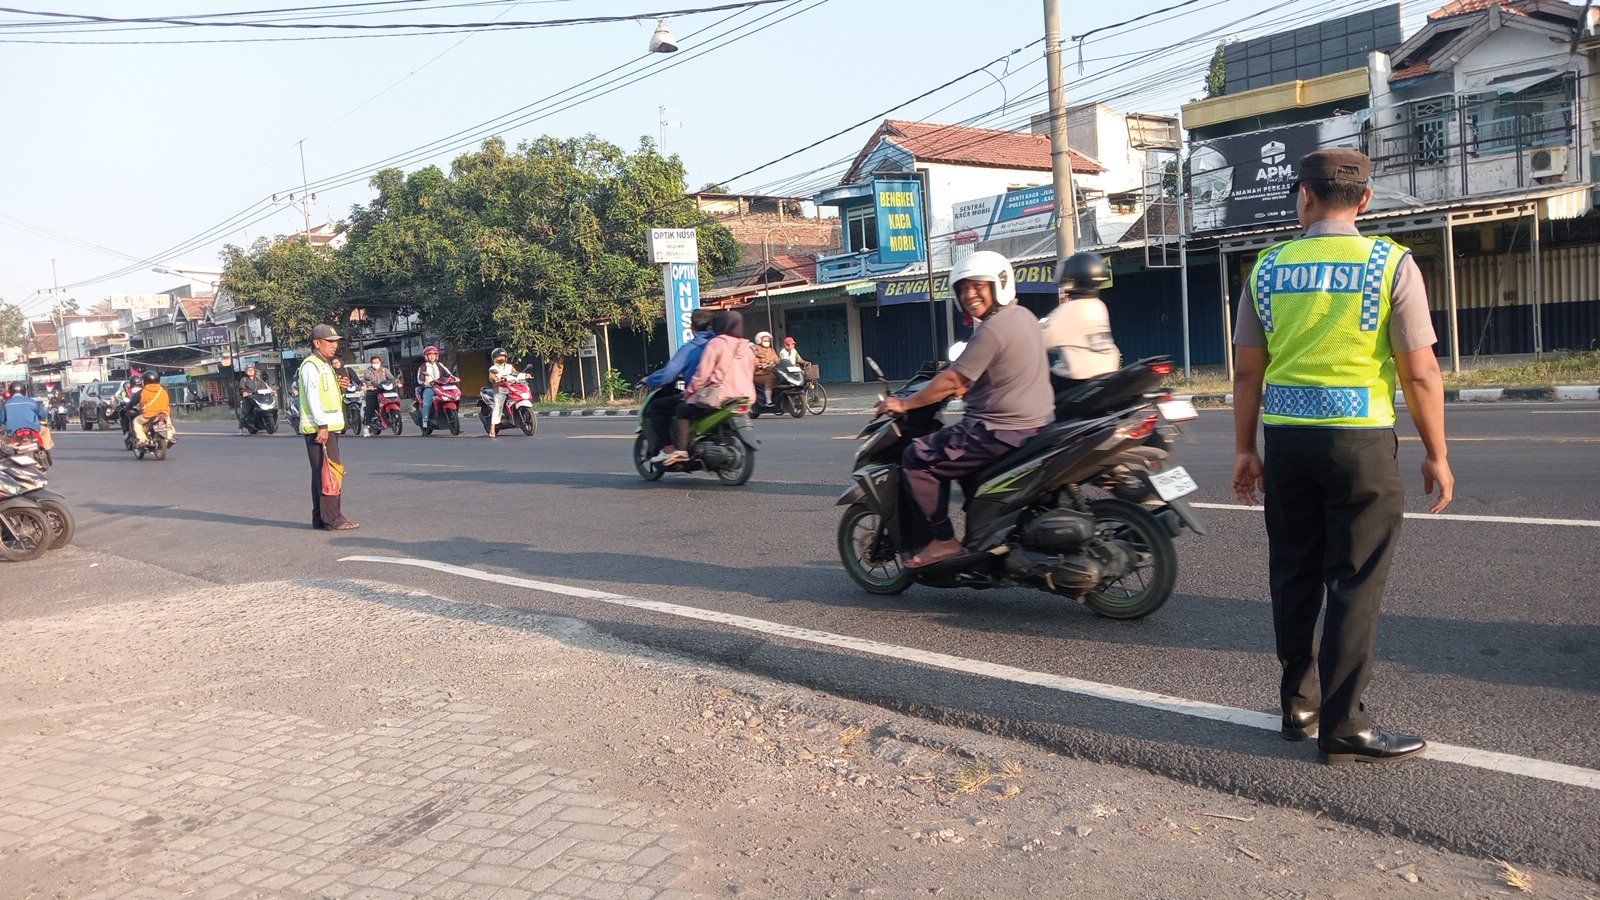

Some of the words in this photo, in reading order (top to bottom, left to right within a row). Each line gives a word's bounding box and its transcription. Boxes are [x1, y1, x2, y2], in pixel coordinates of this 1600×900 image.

[1256, 164, 1292, 180] APM
[880, 191, 914, 207] BENGKEL
[1232, 188, 1262, 196] AMANAH
[954, 212, 970, 220] KACA
[972, 207, 991, 216] MOBIL
[960, 202, 985, 212] SENTRAL
[888, 214, 912, 230] KACA
[654, 231, 674, 240] OPTIK
[676, 230, 695, 239] NUSA
[890, 236, 916, 252] MOBIL
[672, 264, 696, 280] OPTIK
[1016, 266, 1056, 282] OBIL
[1275, 264, 1362, 290] POLISI
[679, 282, 694, 344] NUSA
